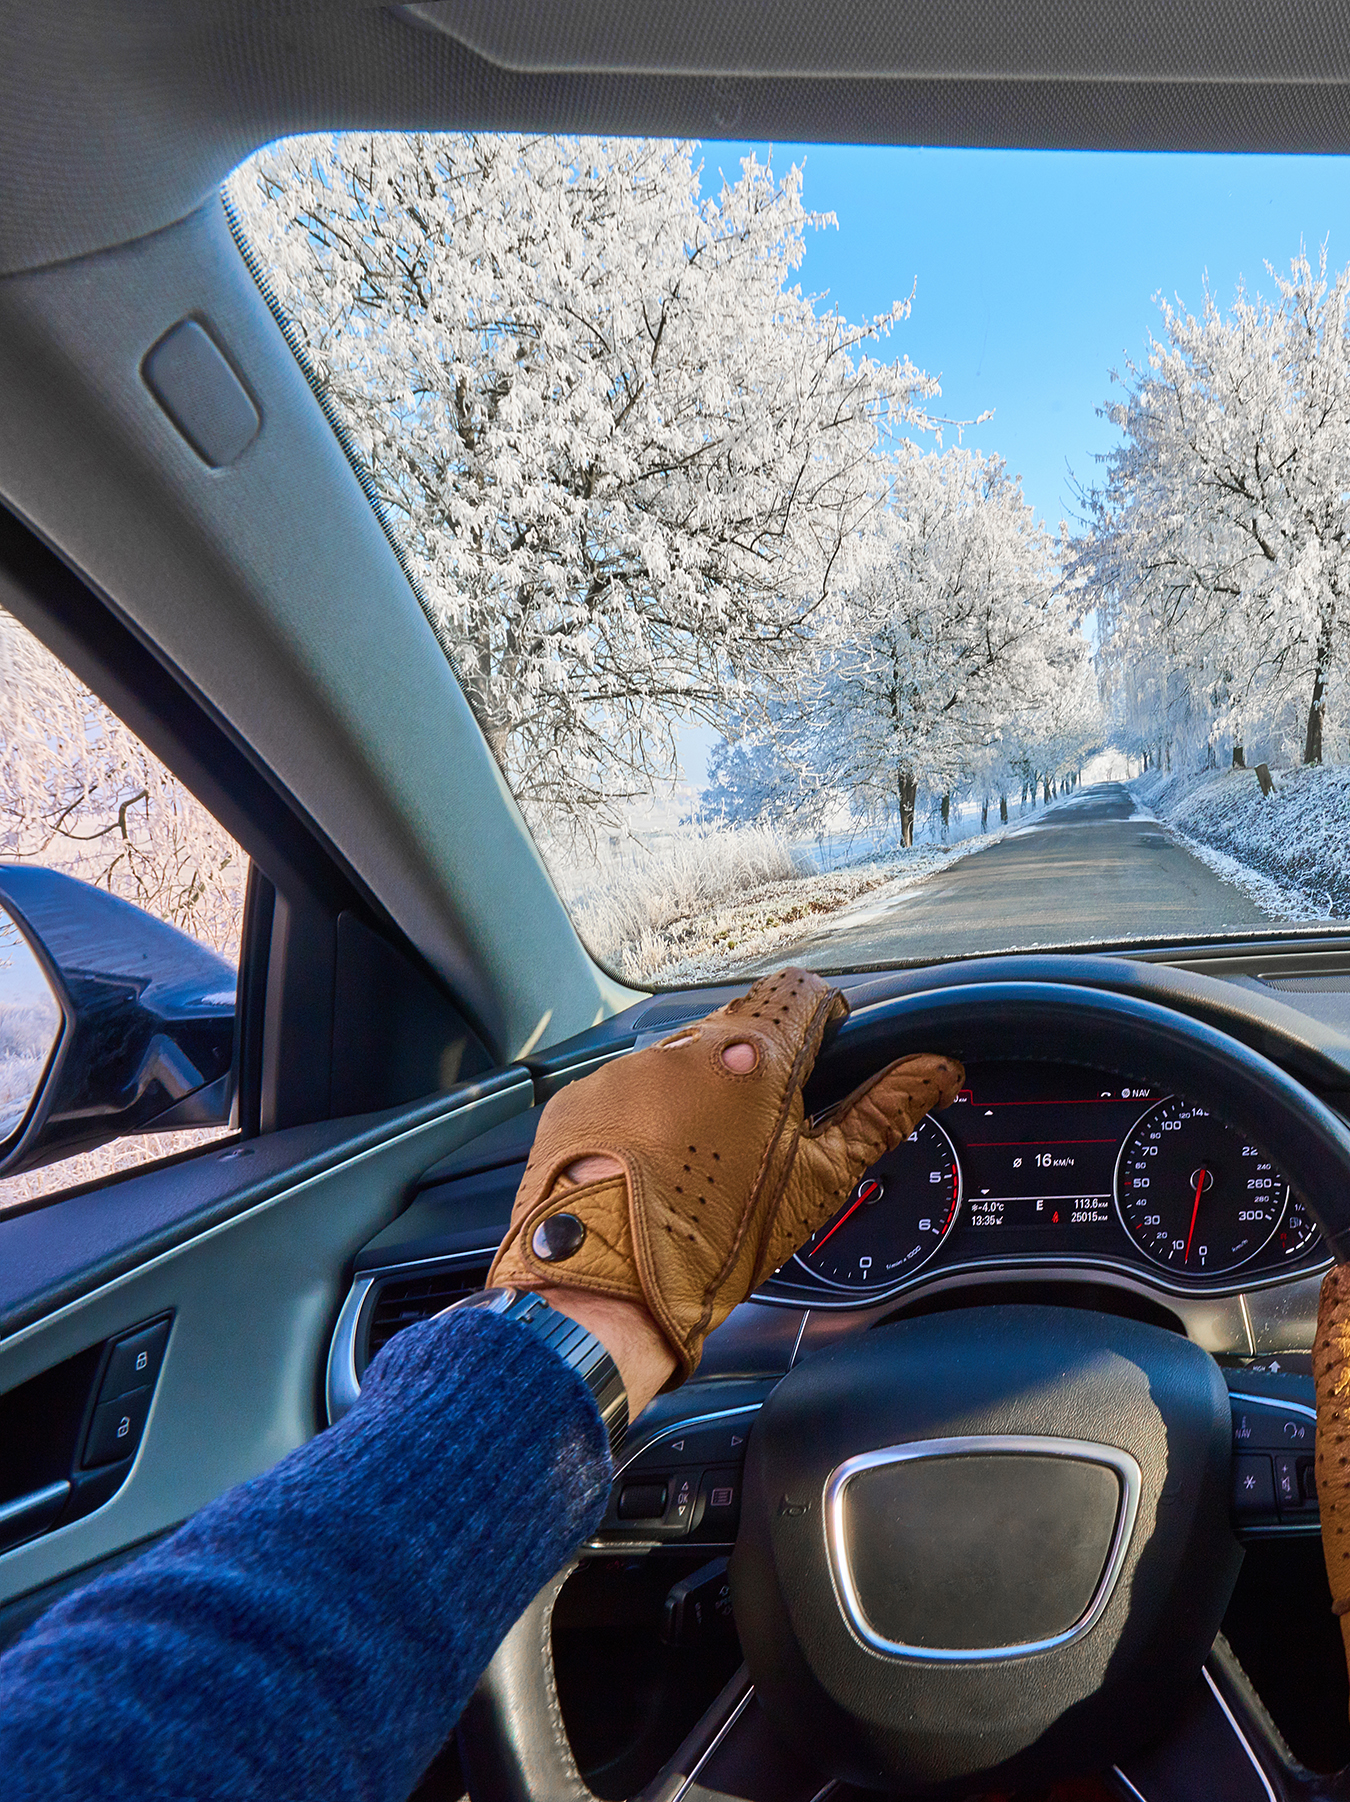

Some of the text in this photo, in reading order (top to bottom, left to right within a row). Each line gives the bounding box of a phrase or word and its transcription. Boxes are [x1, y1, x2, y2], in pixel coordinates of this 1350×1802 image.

[1132, 1089, 1151, 1098] NAV
[1161, 1121, 1181, 1131] 100
[908, 1131, 918, 1142] 4
[1150, 1132, 1161, 1140] 80
[1142, 1146, 1158, 1156] 70
[1242, 1146, 1259, 1156] 22
[1257, 1163, 1272, 1171] 240
[929, 1172, 941, 1183] 5
[1133, 1178, 1150, 1188] 50
[1247, 1178, 1272, 1189] 260
[1254, 1195, 1269, 1203] 280
[1036, 1200, 1044, 1211] E
[971, 1215, 996, 1226] 13:35
[1144, 1215, 1160, 1225] 30
[1238, 1210, 1264, 1221] 300
[918, 1219, 931, 1231] 6
[1172, 1240, 1185, 1250] 10
[1199, 1245, 1208, 1256] 0
[859, 1256, 872, 1268] 0
[678, 1492, 690, 1505] OK
